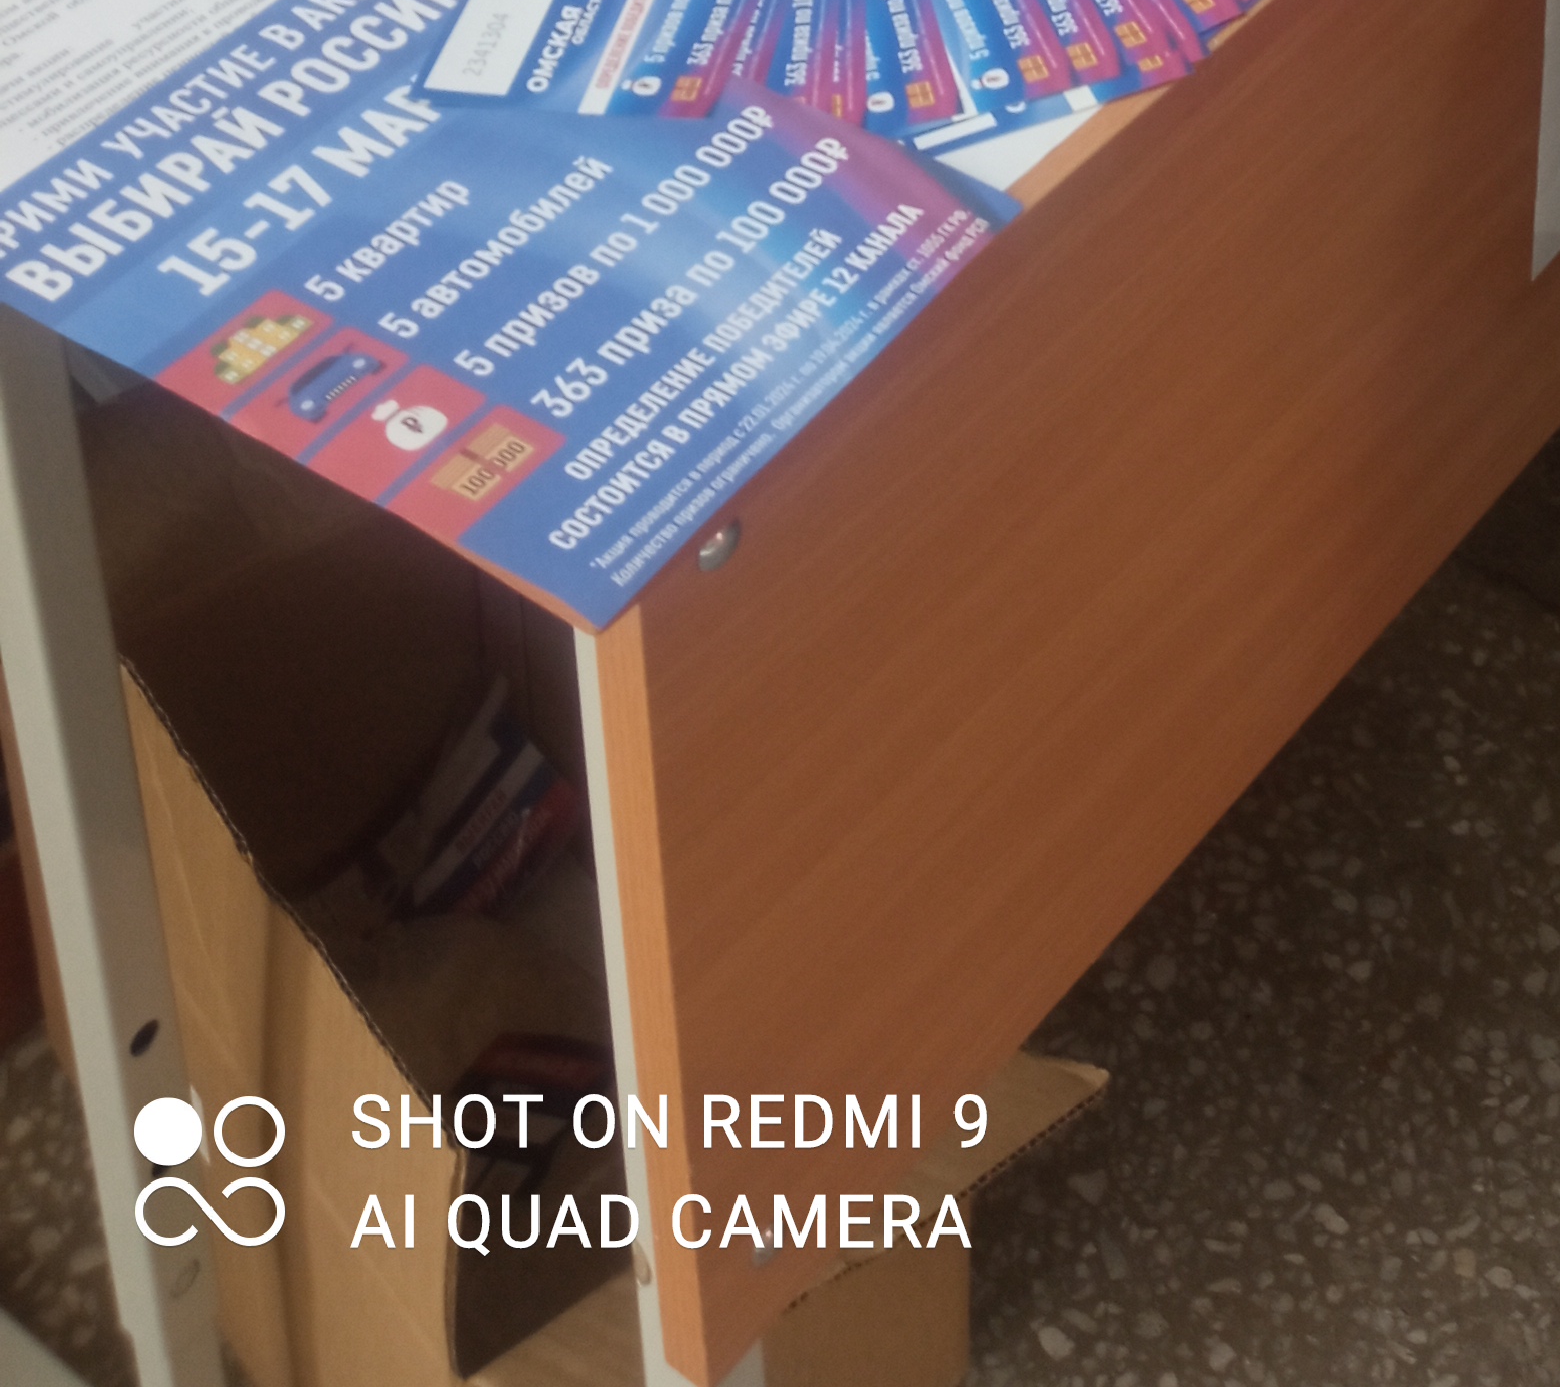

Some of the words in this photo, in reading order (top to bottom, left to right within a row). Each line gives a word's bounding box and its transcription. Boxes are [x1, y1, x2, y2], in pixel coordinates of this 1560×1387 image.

[101, 42, 276, 159] УЧАСТИЕ
[259, 22, 307, 52] В
[462, 12, 510, 79] 2341304
[527, 5, 583, 94] ОМСКАЯ
[3, 104, 286, 303] ВЫБИРАЙ
[157, 164, 334, 298] 15-17
[304, 273, 346, 302] 5
[336, 179, 473, 284] квартир
[378, 311, 420, 339] 5
[409, 154, 614, 321] автомобилей
[453, 349, 495, 379] 5
[490, 261, 602, 358] призов
[596, 232, 640, 269] по
[620, 211, 660, 234] 1
[641, 163, 713, 216] 000
[530, 356, 609, 420] 363
[597, 287, 700, 369] приза
[685, 250, 736, 288] по
[715, 199, 788, 256] 100
[547, 428, 675, 553] СОСТОИТСЯ
[673, 414, 693, 445] В
[684, 347, 777, 427] ПРЯМОМ
[762, 294, 839, 356] ЭФИРЕ
[823, 266, 854, 296] 12
[847, 201, 925, 273] КАНАЛА
[564, 331, 718, 484] ОПРЕДЕЛЕНИЕ
[702, 226, 844, 356] ПОБЕДИТЕЛЕЙ
